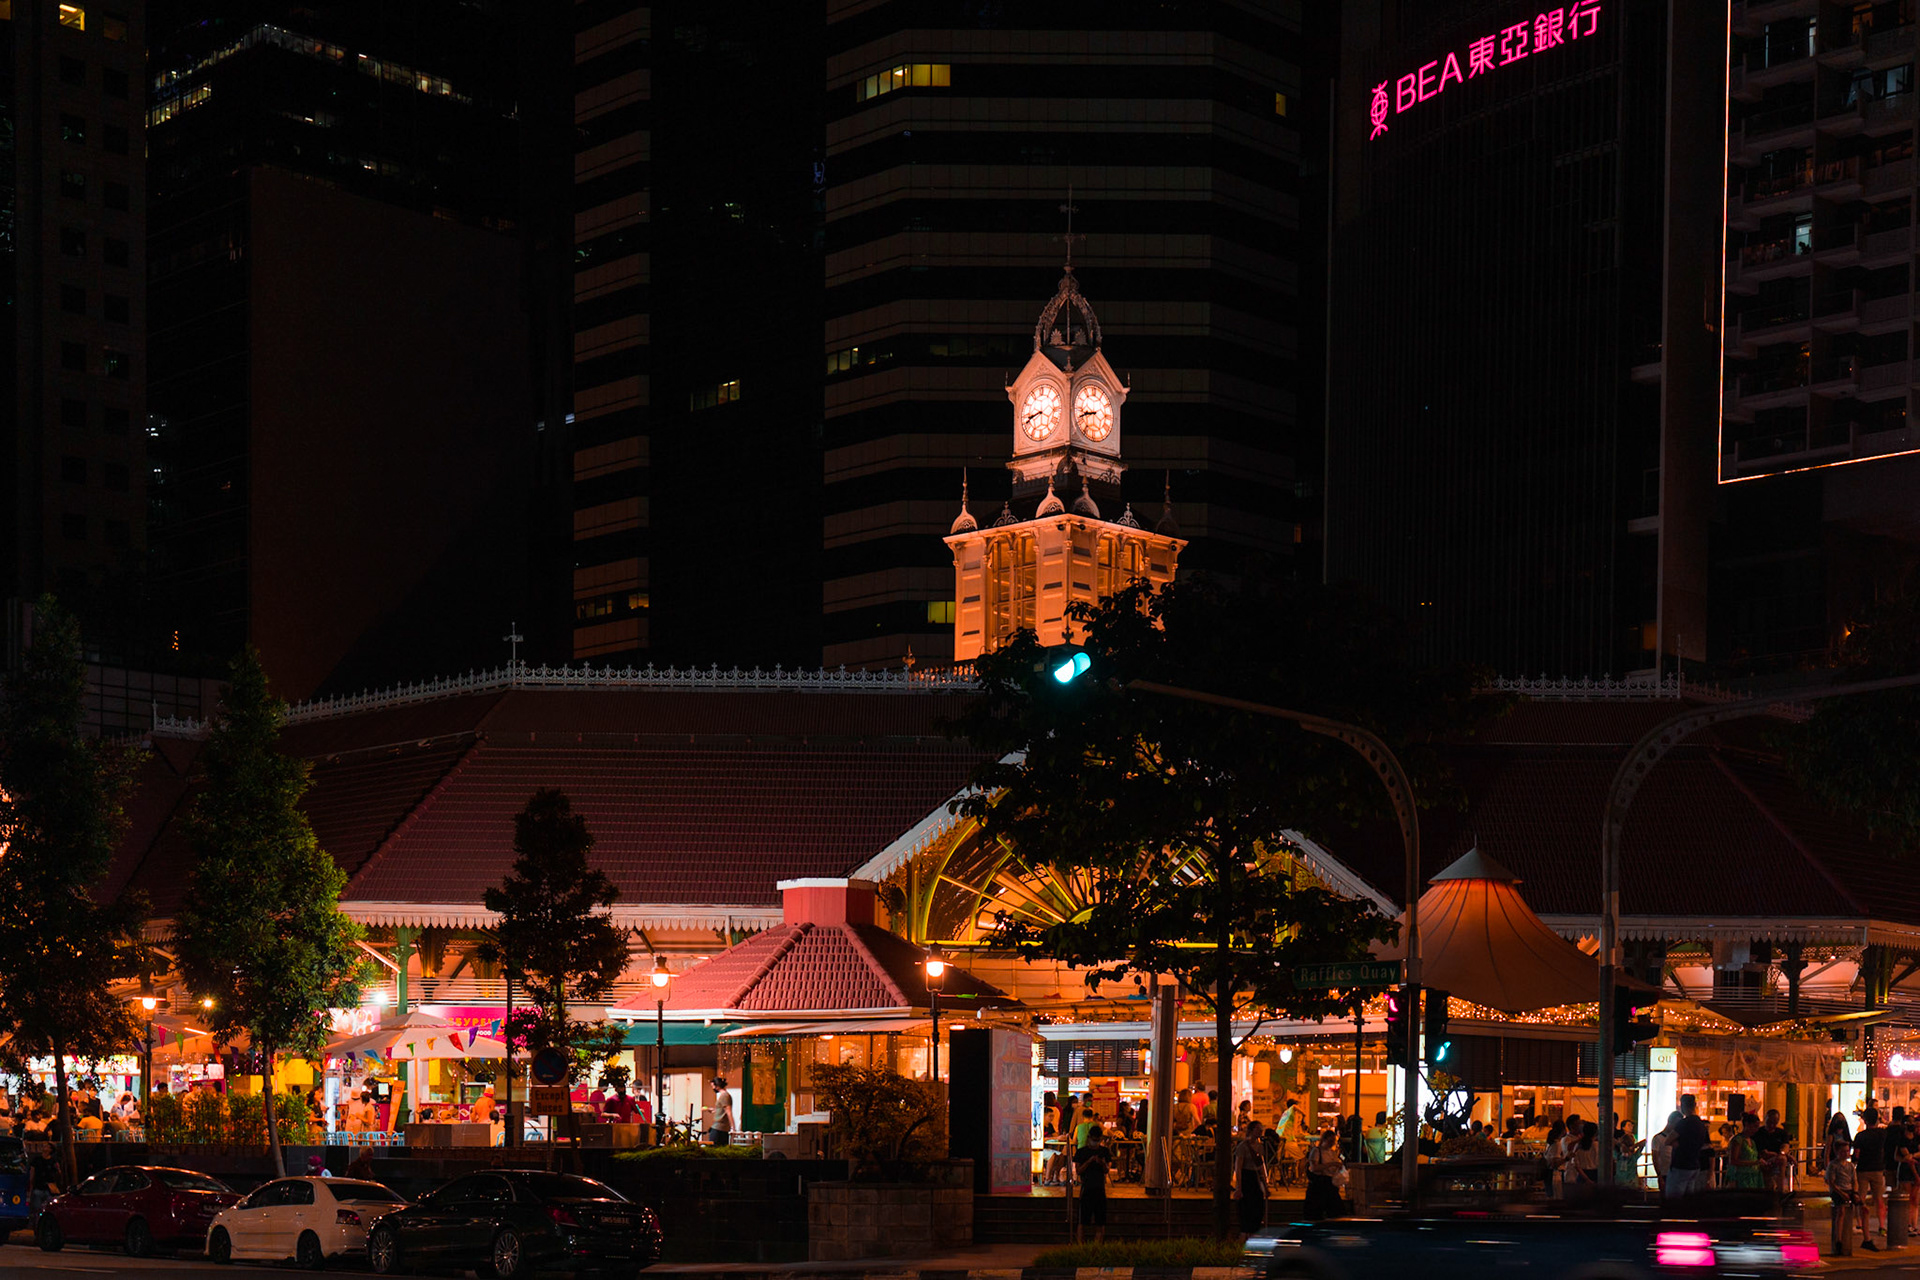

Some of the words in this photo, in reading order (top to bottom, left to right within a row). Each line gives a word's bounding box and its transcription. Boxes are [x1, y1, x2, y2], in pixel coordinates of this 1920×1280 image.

[1396, 52, 1464, 114] BEA
[1468, 0, 1601, 79] 東亞銀行
[1300, 965, 1352, 982] Raffles
[1360, 964, 1396, 982] Quay
[535, 1090, 564, 1102] Except
[536, 1102, 563, 1112] Buses
